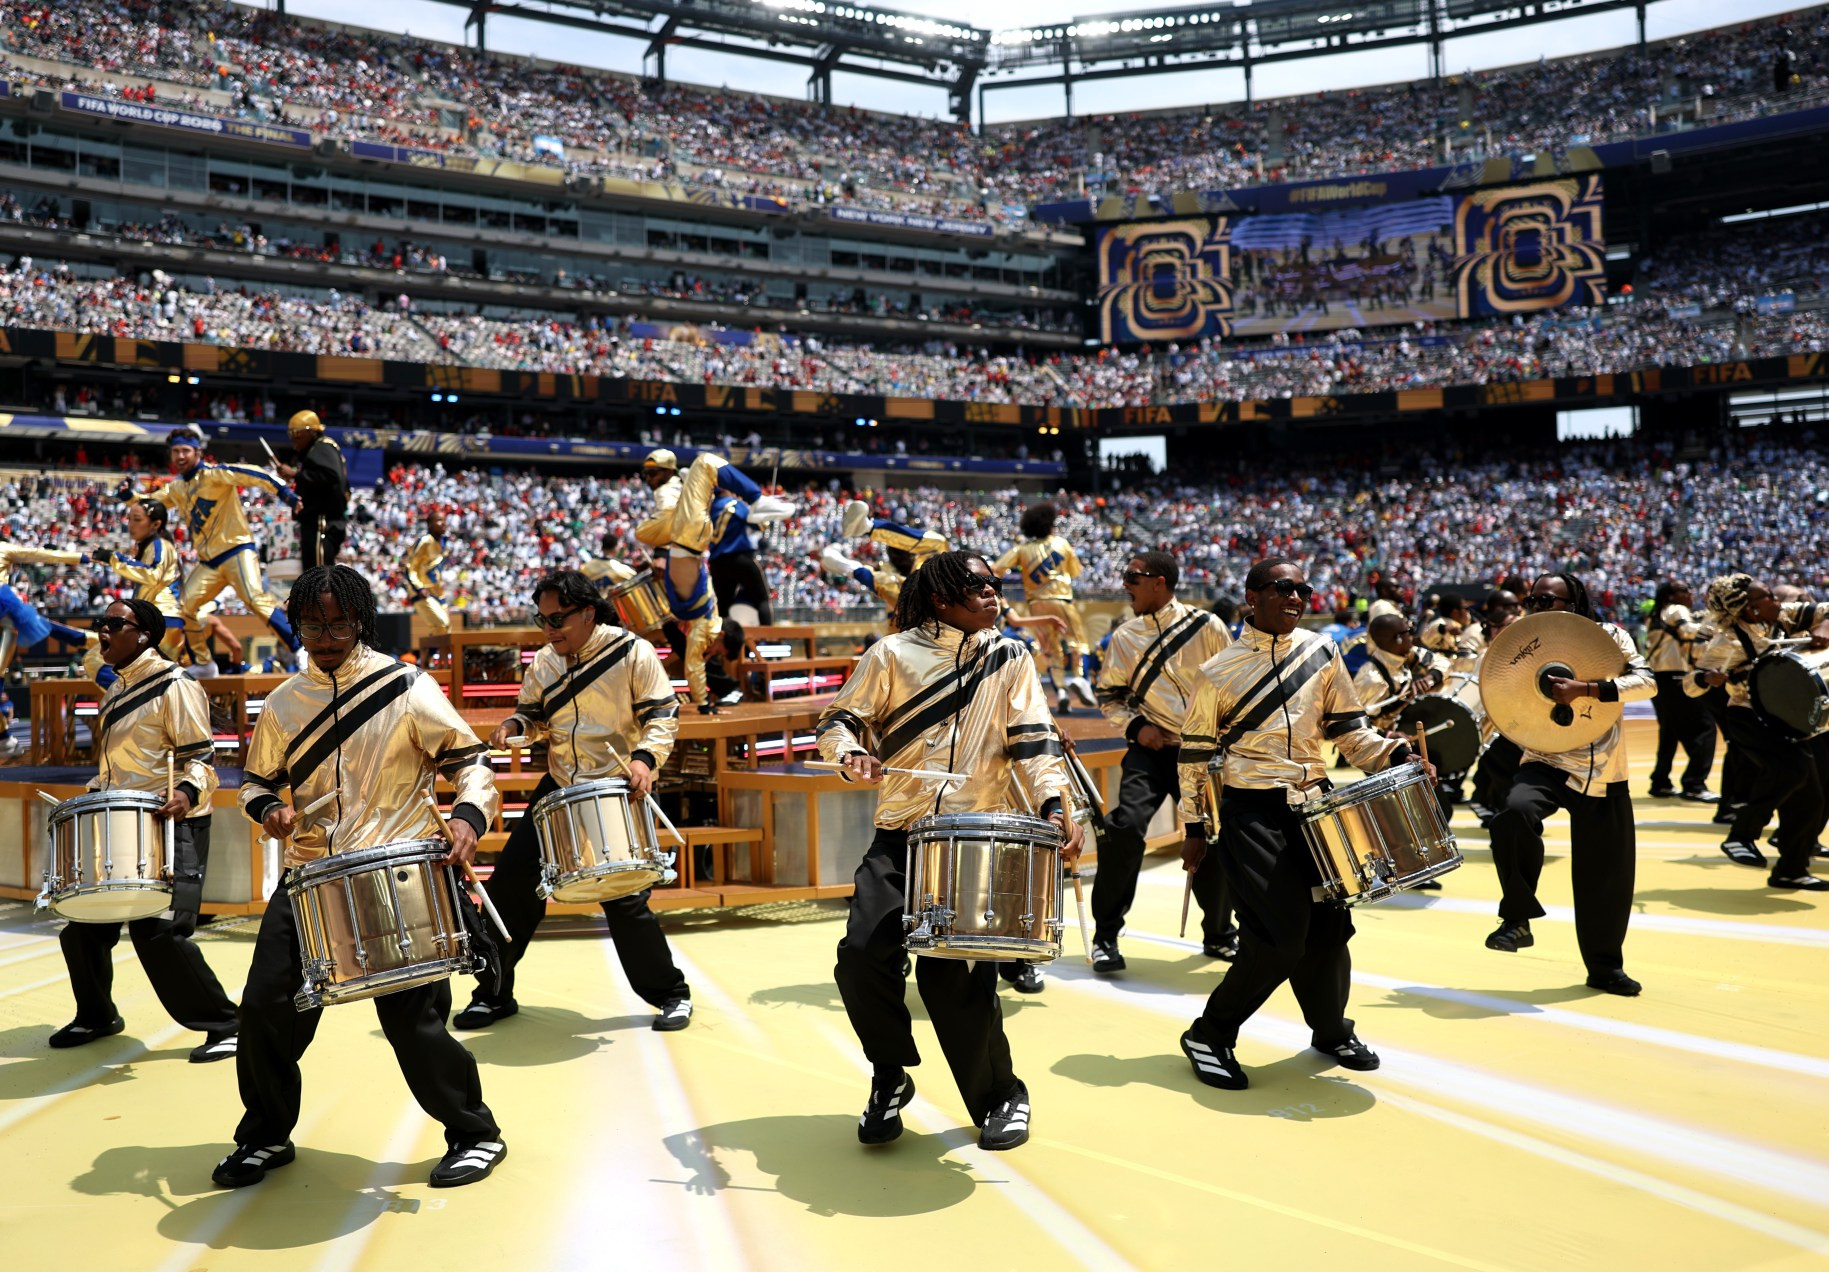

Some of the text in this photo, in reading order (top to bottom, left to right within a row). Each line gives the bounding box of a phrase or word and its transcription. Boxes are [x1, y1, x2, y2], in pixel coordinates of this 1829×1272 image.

[78, 97, 296, 142] FIFA WORLD CUP 2026 THE FINAL
[837, 209, 986, 234] NEW YORK NEW JERSEY
[1694, 361, 1753, 384] FIFA
[627, 381, 678, 401] FIFA
[1124, 405, 1173, 424] FIFA
[1030, 551, 1064, 584] FIFA
[1509, 637, 1541, 665] Zildjian
